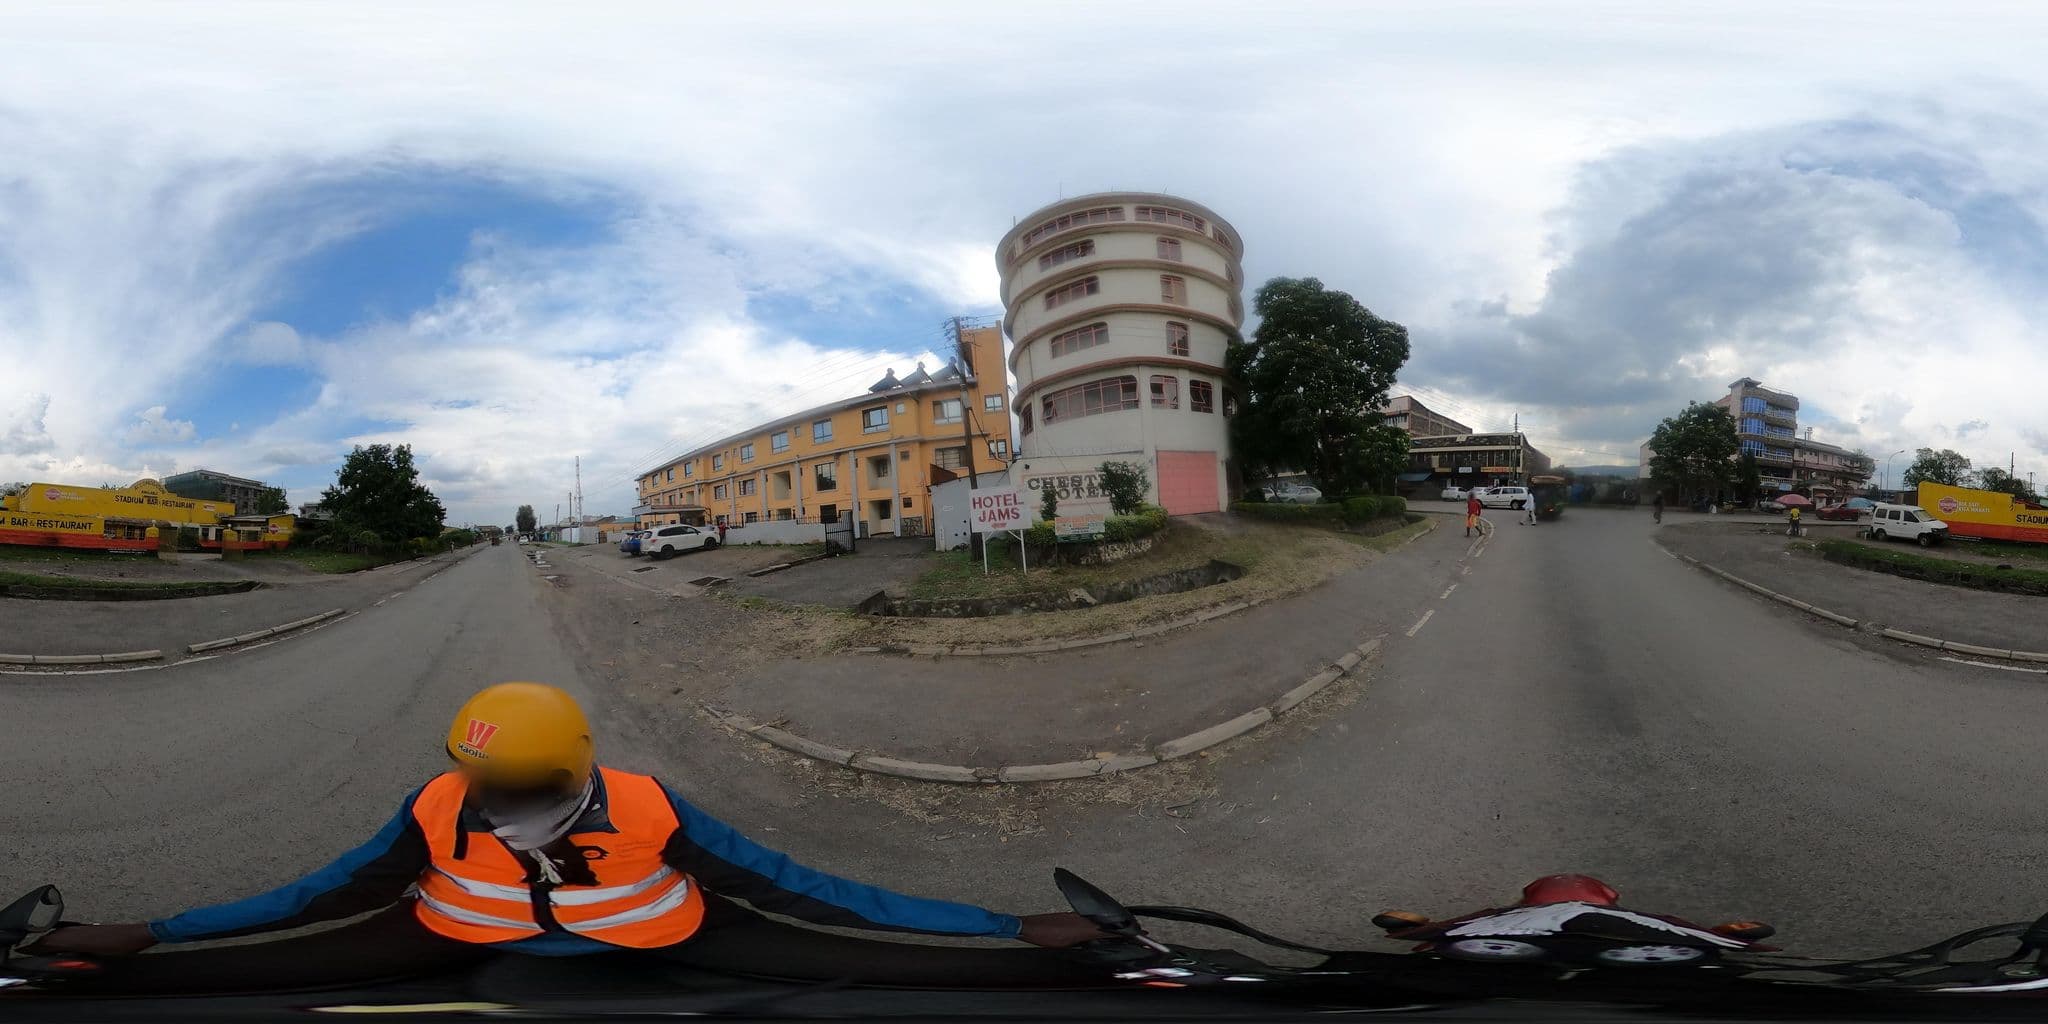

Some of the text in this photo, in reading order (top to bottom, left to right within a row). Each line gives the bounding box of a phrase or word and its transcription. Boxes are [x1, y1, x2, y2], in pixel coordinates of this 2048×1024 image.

[1056, 485, 1111, 500] OTEL
[115, 495, 144, 504] STADIUM
[162, 500, 196, 509] RESTAURANT
[972, 493, 1024, 509] HOTEL
[979, 507, 1020, 522] JAMS
[11, 517, 28, 527] BAR
[36, 519, 94, 531] RESTAURANT
